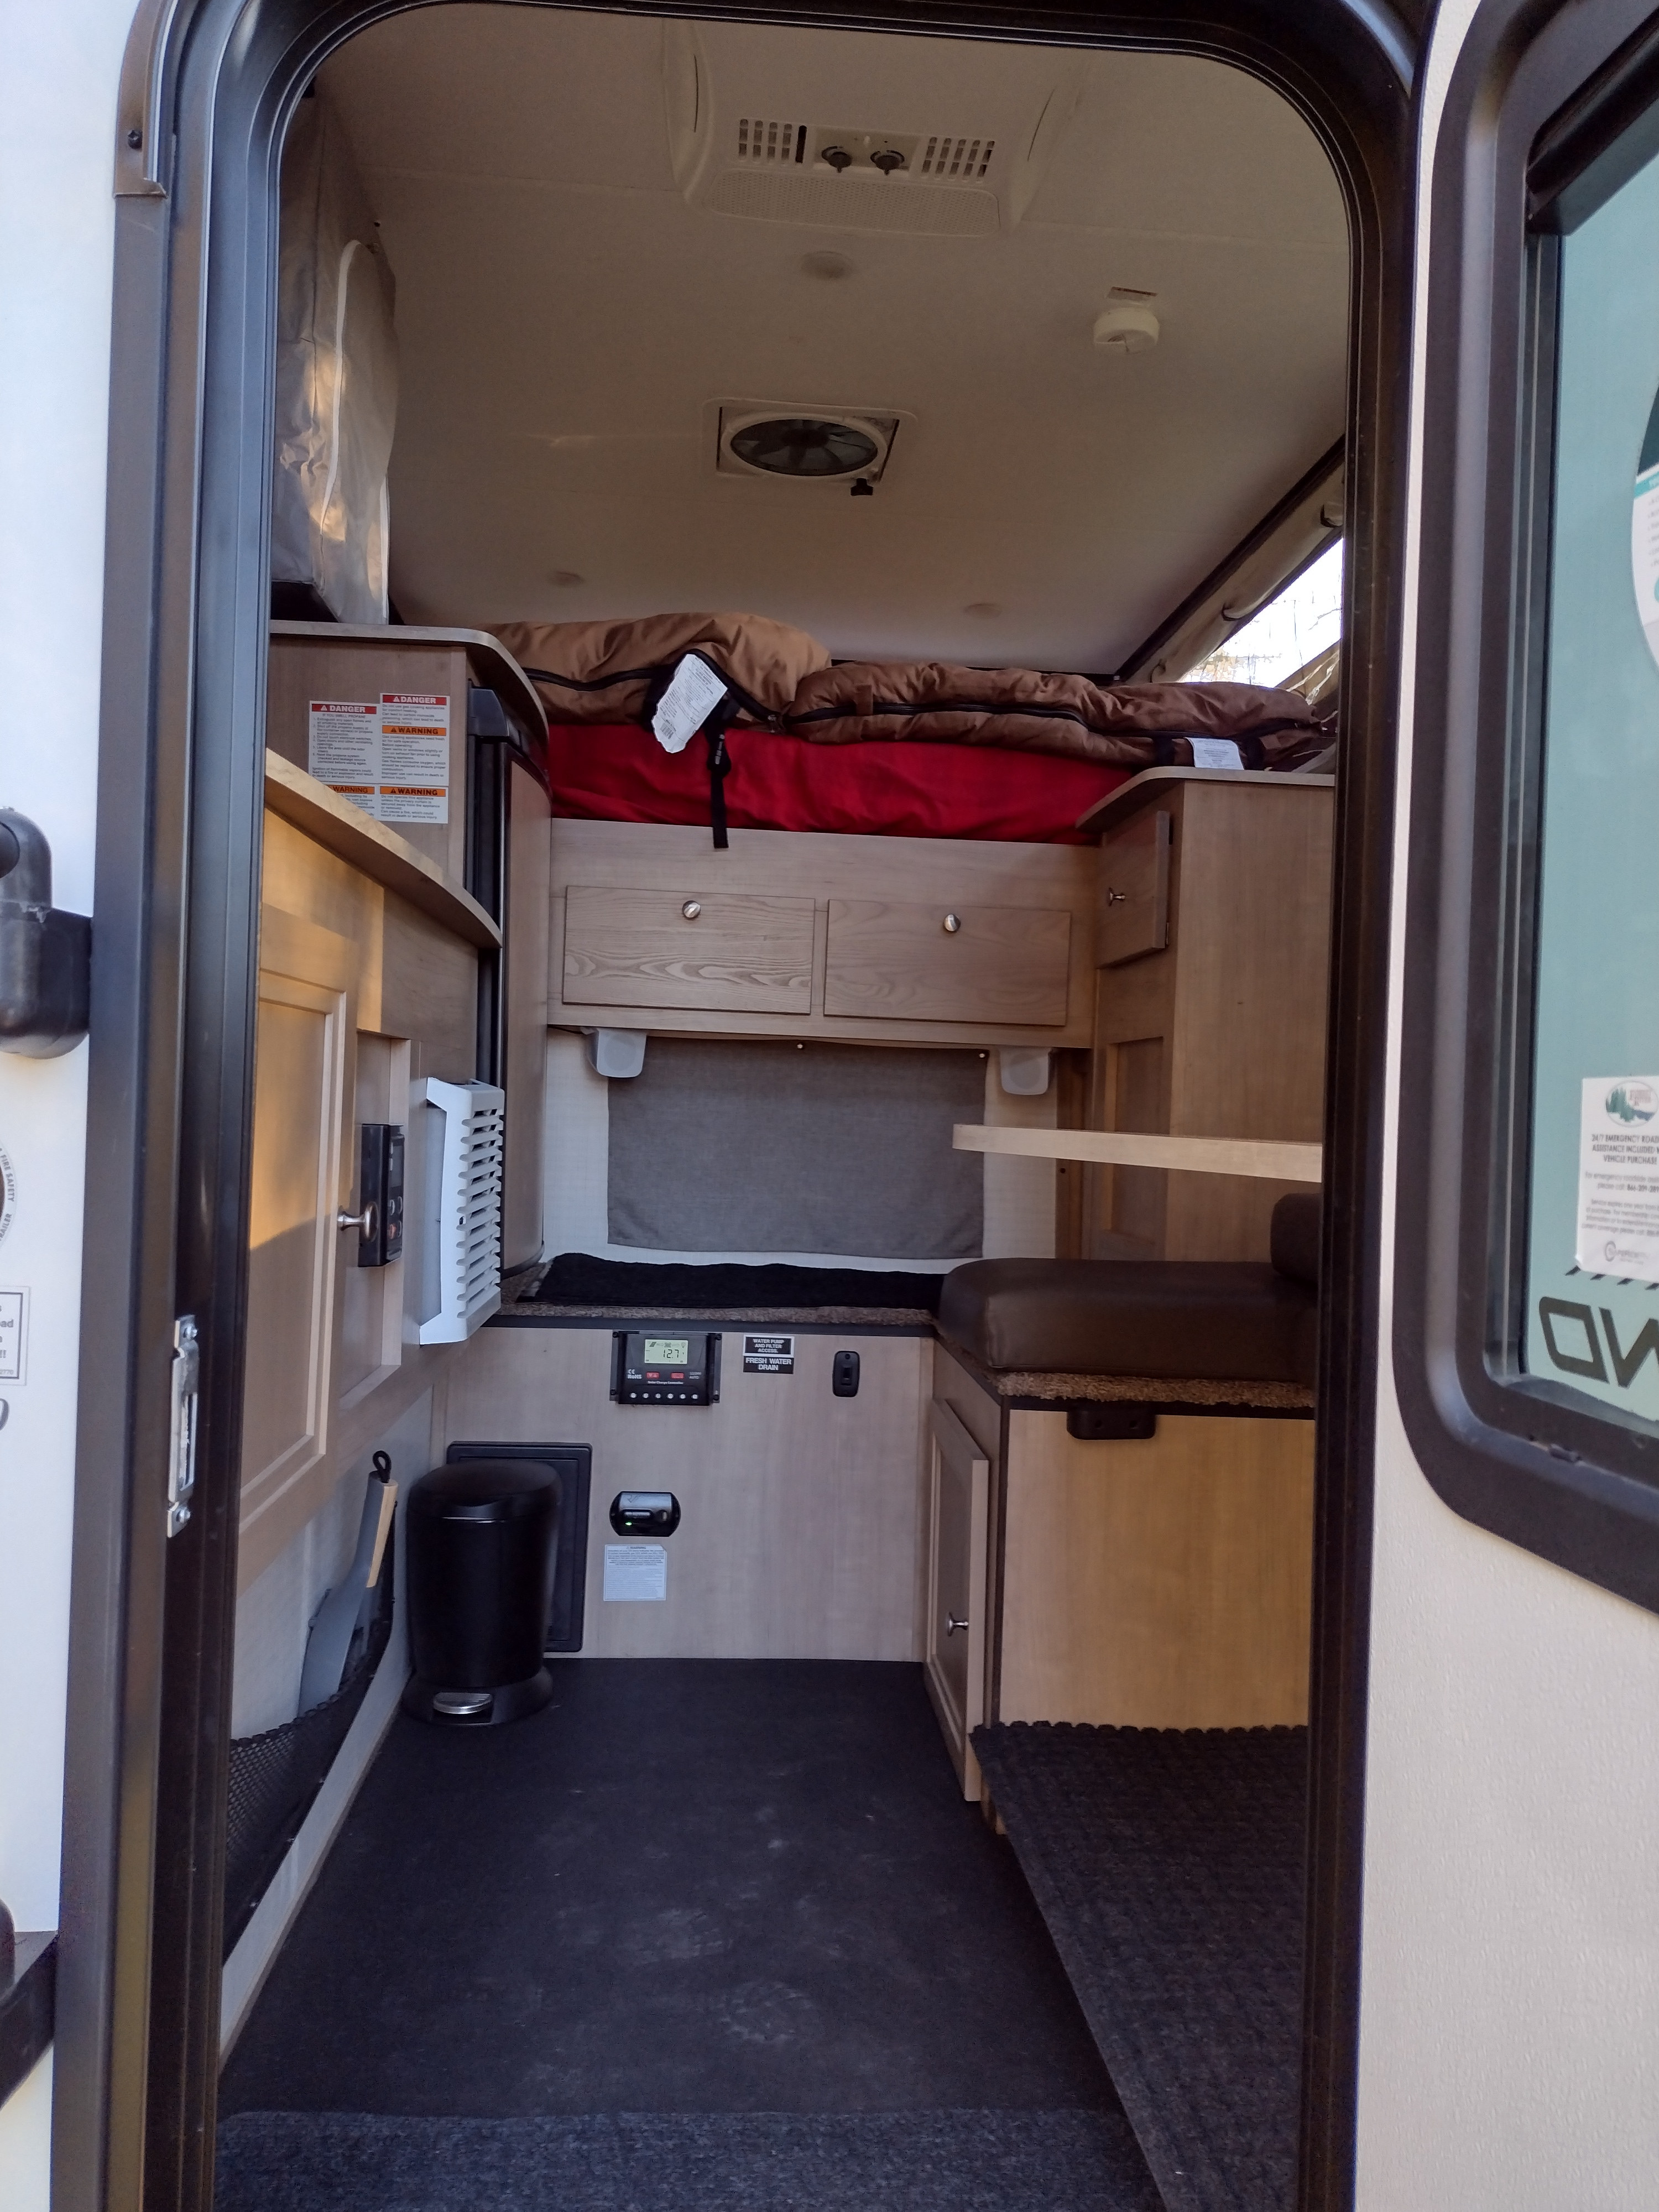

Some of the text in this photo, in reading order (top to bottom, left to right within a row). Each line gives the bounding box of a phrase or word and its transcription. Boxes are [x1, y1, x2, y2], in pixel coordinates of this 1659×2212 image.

[1605, 1134, 1640, 1142] EMERGENCY
[1626, 1145, 1655, 1154] INCLUDED
[1627, 1156, 1657, 1165] PURCHASE
[6, 1172, 15, 1202] SAFETY
[663, 1349, 679, 1359] 12.7
